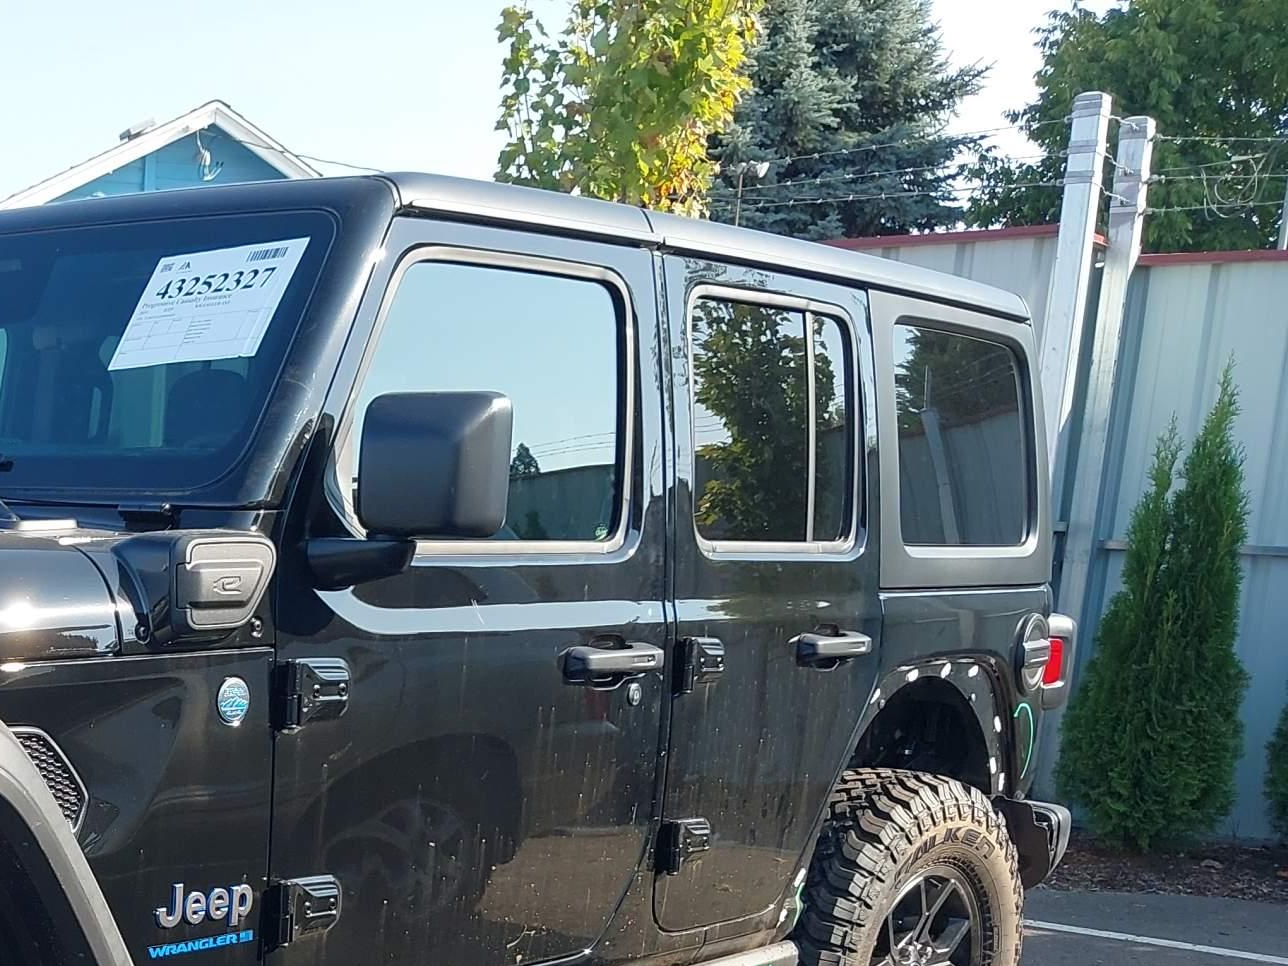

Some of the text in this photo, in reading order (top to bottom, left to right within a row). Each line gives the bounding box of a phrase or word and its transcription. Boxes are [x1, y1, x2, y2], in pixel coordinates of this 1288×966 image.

[156, 266, 277, 299] 43252327
[153, 883, 253, 928] Jeep
[147, 934, 238, 959] WRANGLER
